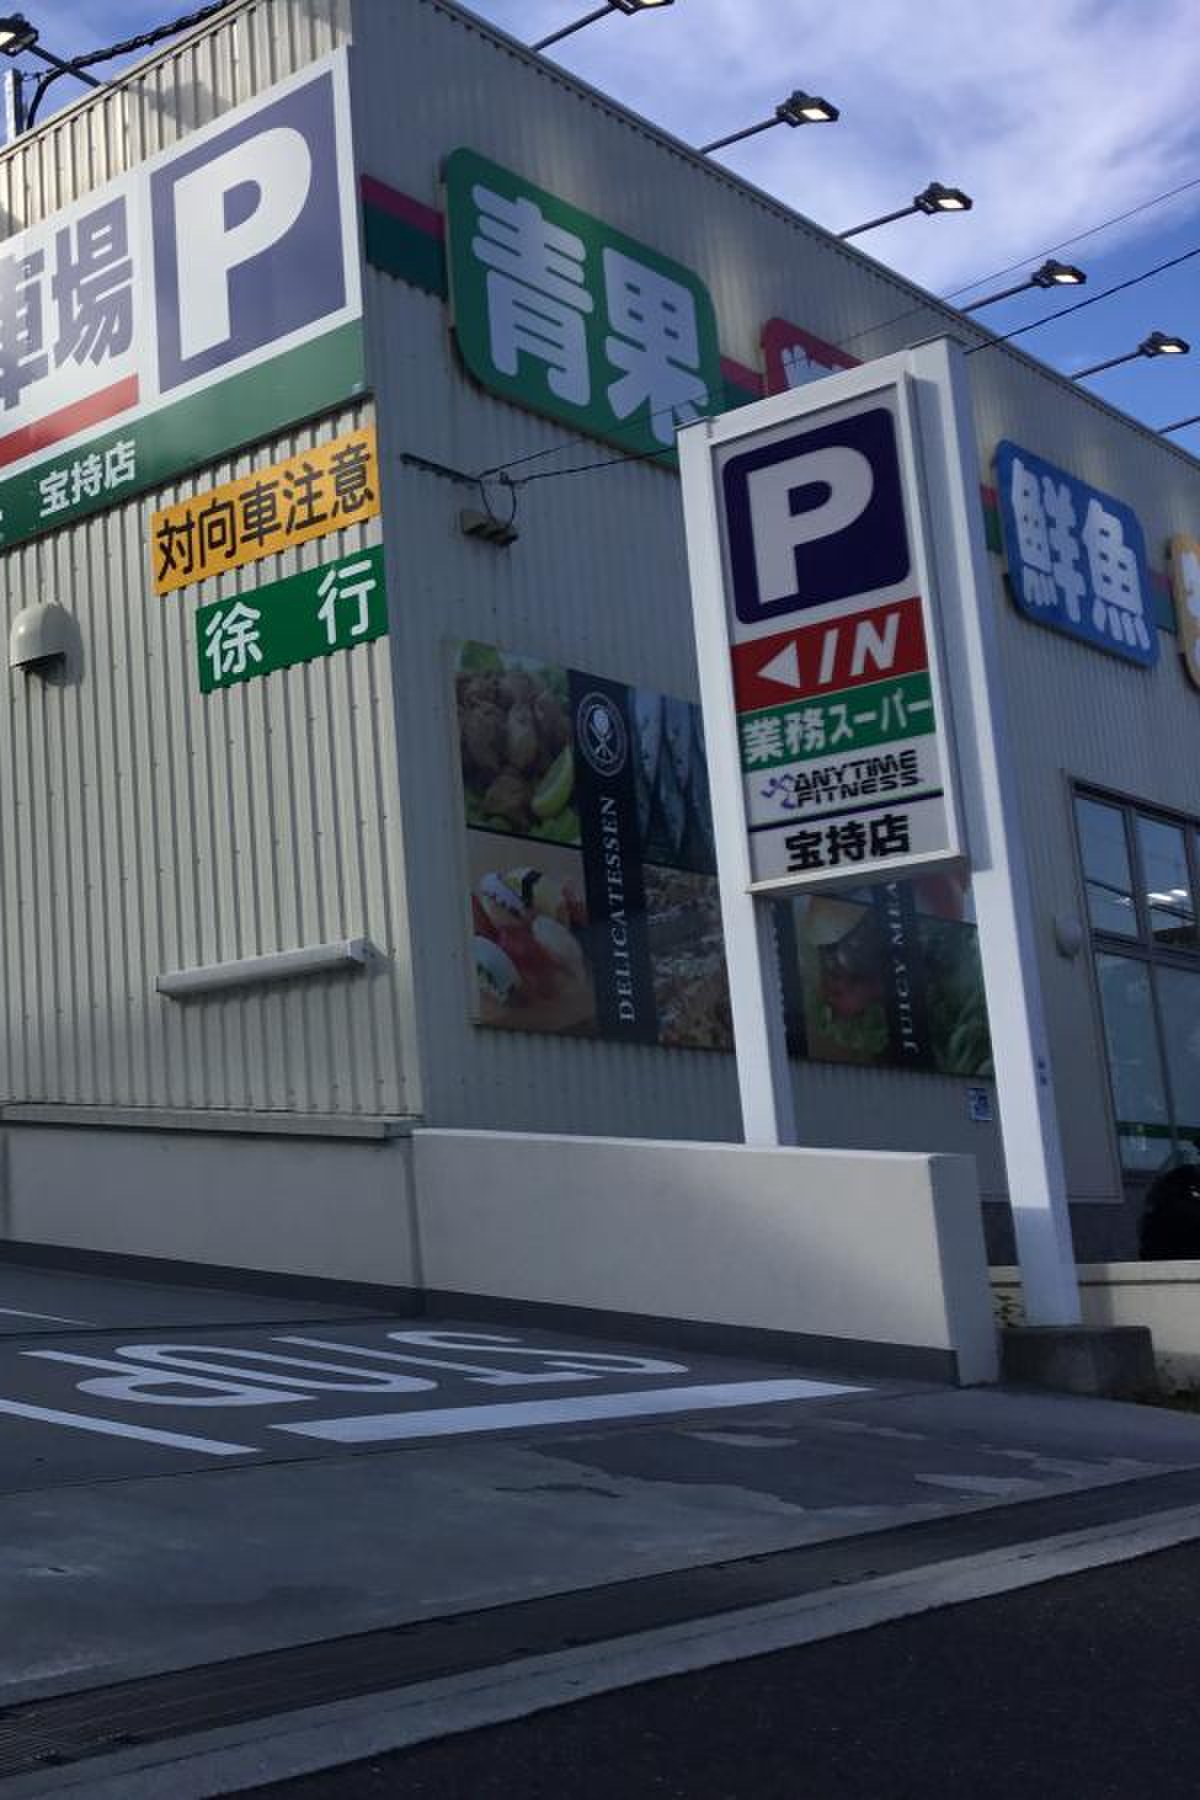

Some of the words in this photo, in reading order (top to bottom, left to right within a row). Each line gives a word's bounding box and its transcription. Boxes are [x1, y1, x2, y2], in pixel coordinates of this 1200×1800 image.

[172, 126, 313, 362] P
[472, 183, 709, 447] 青果
[38, 441, 137, 518] 宝持店
[155, 444, 375, 582] 対向車注意
[746, 446, 874, 603] P
[1012, 457, 1150, 650] 鮮魚
[817, 612, 900, 685] IN
[742, 688, 932, 765] 業務スーパー
[795, 749, 918, 793] ANYTIME
[796, 769, 919, 808] FITNESS
[785, 814, 910, 872] 宝持店
[601, 797, 637, 1024] DELICATESSEN
[22, 1329, 689, 1406] STOP
